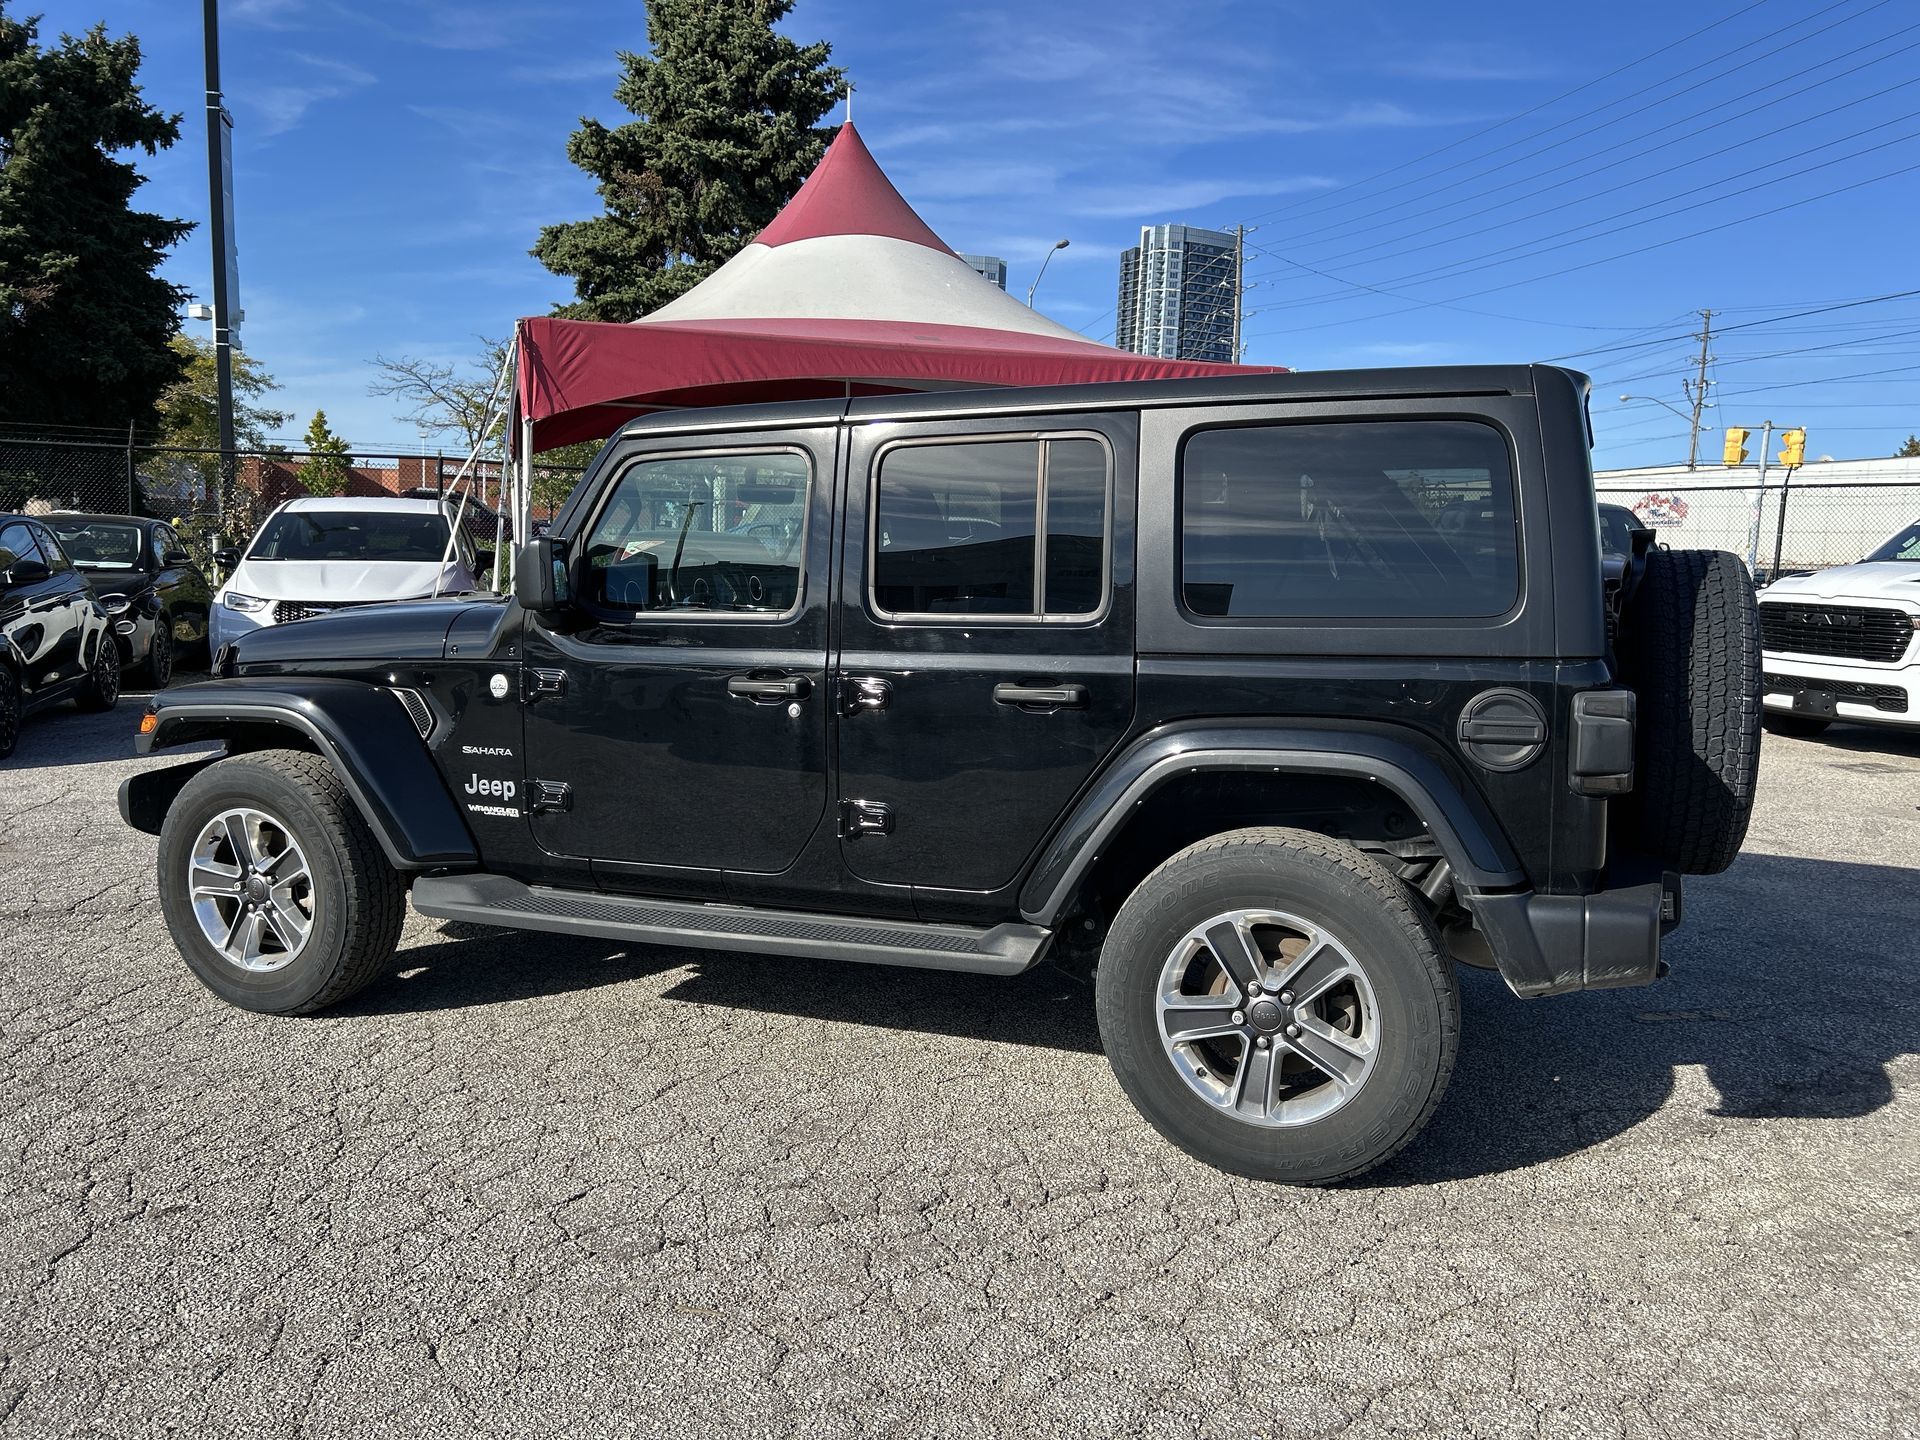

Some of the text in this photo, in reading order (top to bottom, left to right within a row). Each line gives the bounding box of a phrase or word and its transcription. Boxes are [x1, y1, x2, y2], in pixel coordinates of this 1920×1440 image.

[462, 745, 513, 757] SAHARA
[464, 773, 516, 801] Jeep
[467, 804, 519, 815] WRANGLER
[277, 795, 339, 975] BRIDGESTONE
[1110, 871, 1220, 1072] BRIDGESTONE
